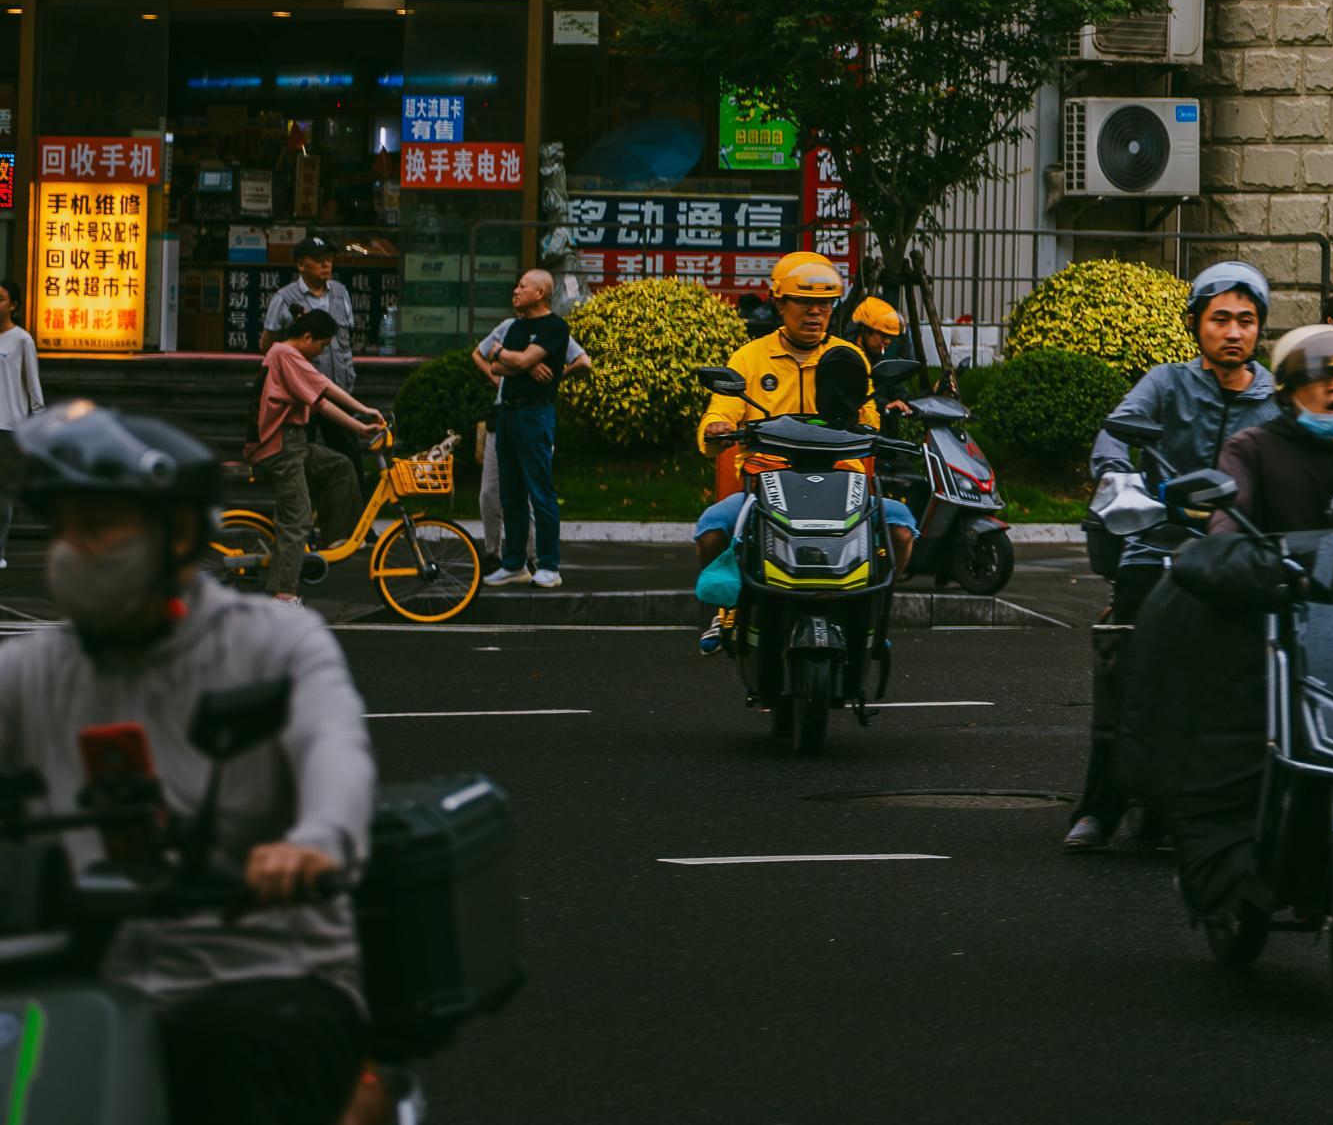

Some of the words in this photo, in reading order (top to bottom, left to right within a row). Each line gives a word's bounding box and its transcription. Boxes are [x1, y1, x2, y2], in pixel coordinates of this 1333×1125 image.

[405, 97, 460, 119] 超大流量卡
[411, 119, 454, 141] 有售
[42, 142, 156, 178] 回收手机
[405, 147, 521, 183] 换手表电池
[47, 193, 140, 216] 手机维修
[45, 220, 140, 243] 手机卡号及配件
[45, 249, 138, 271] 回收手机
[44, 276, 139, 298] 各类超市卡
[44, 308, 138, 331] 福利彩票
